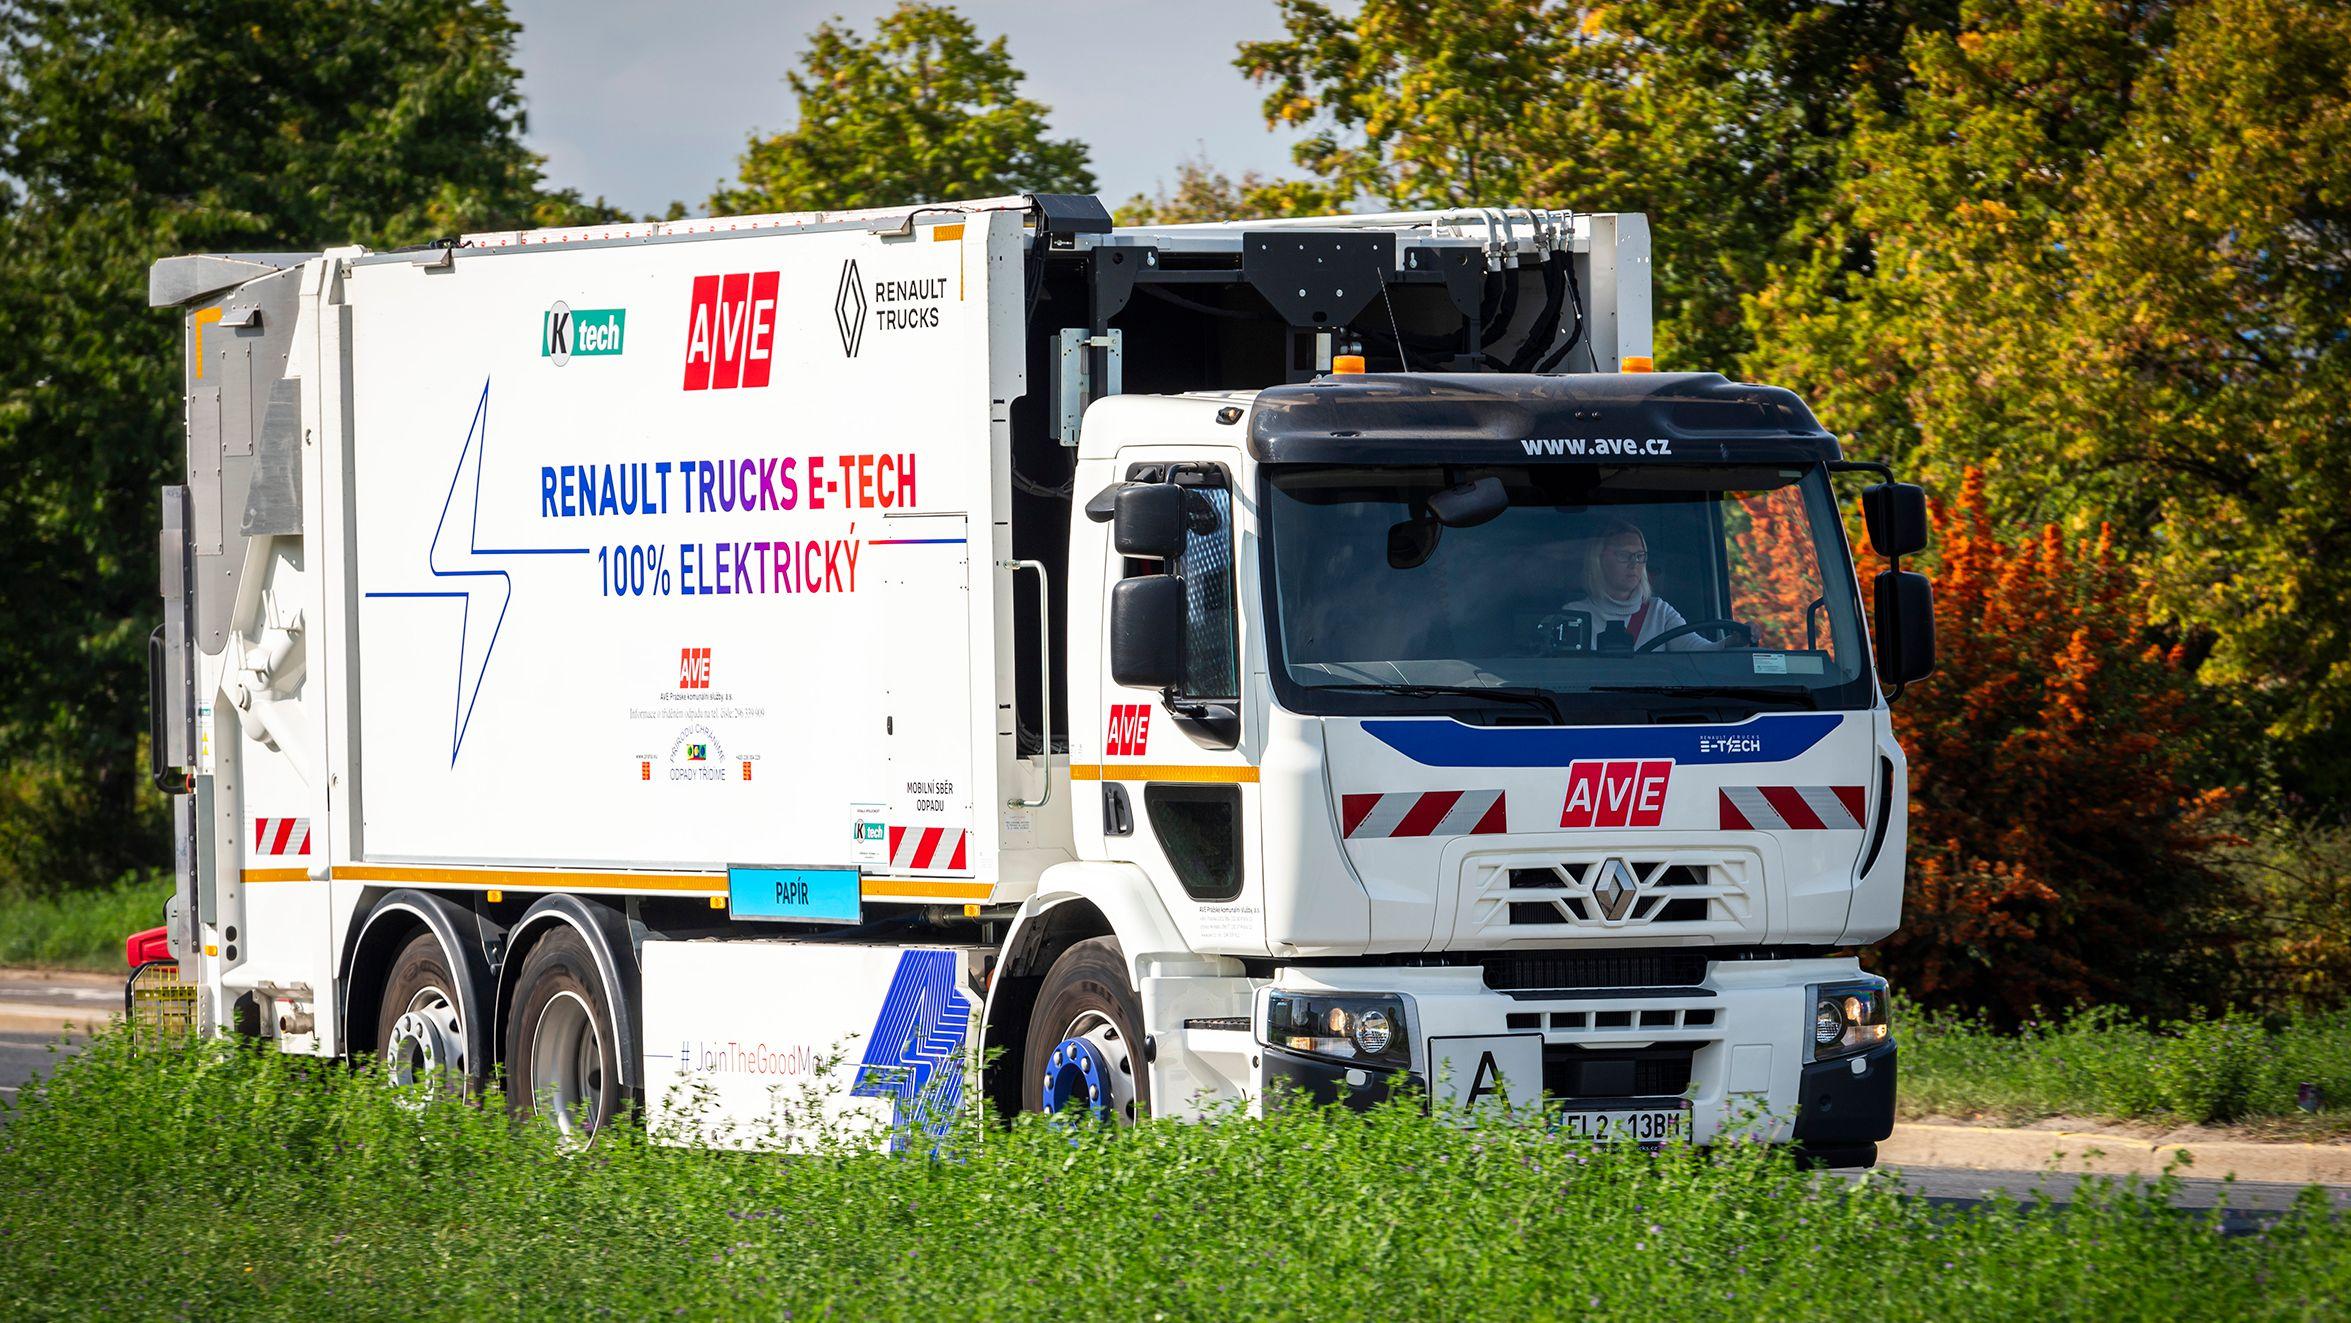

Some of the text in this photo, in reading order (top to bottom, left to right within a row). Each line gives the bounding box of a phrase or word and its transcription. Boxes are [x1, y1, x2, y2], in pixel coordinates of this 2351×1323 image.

[875, 278, 946, 302] RENAULT
[687, 299, 775, 364] AVE
[876, 307, 939, 330] TRUCKS
[1521, 437, 1673, 456] www.ave.cz
[541, 453, 917, 518] RENAULT TRUCKS E-TECH
[598, 522, 860, 597] 100% ELEKTRICKÝ
[680, 658, 710, 682] AVE
[1108, 716, 1148, 744] AVE
[1700, 740, 1760, 753] E-TECH
[906, 779, 935, 794] MOBILNÍ
[1566, 776, 1665, 812] AVE
[917, 799, 945, 812] ODPADU
[776, 876, 809, 905] PAPÍR
[1463, 1051, 1513, 1115] A
[1627, 1112, 1680, 1139] 13BM
